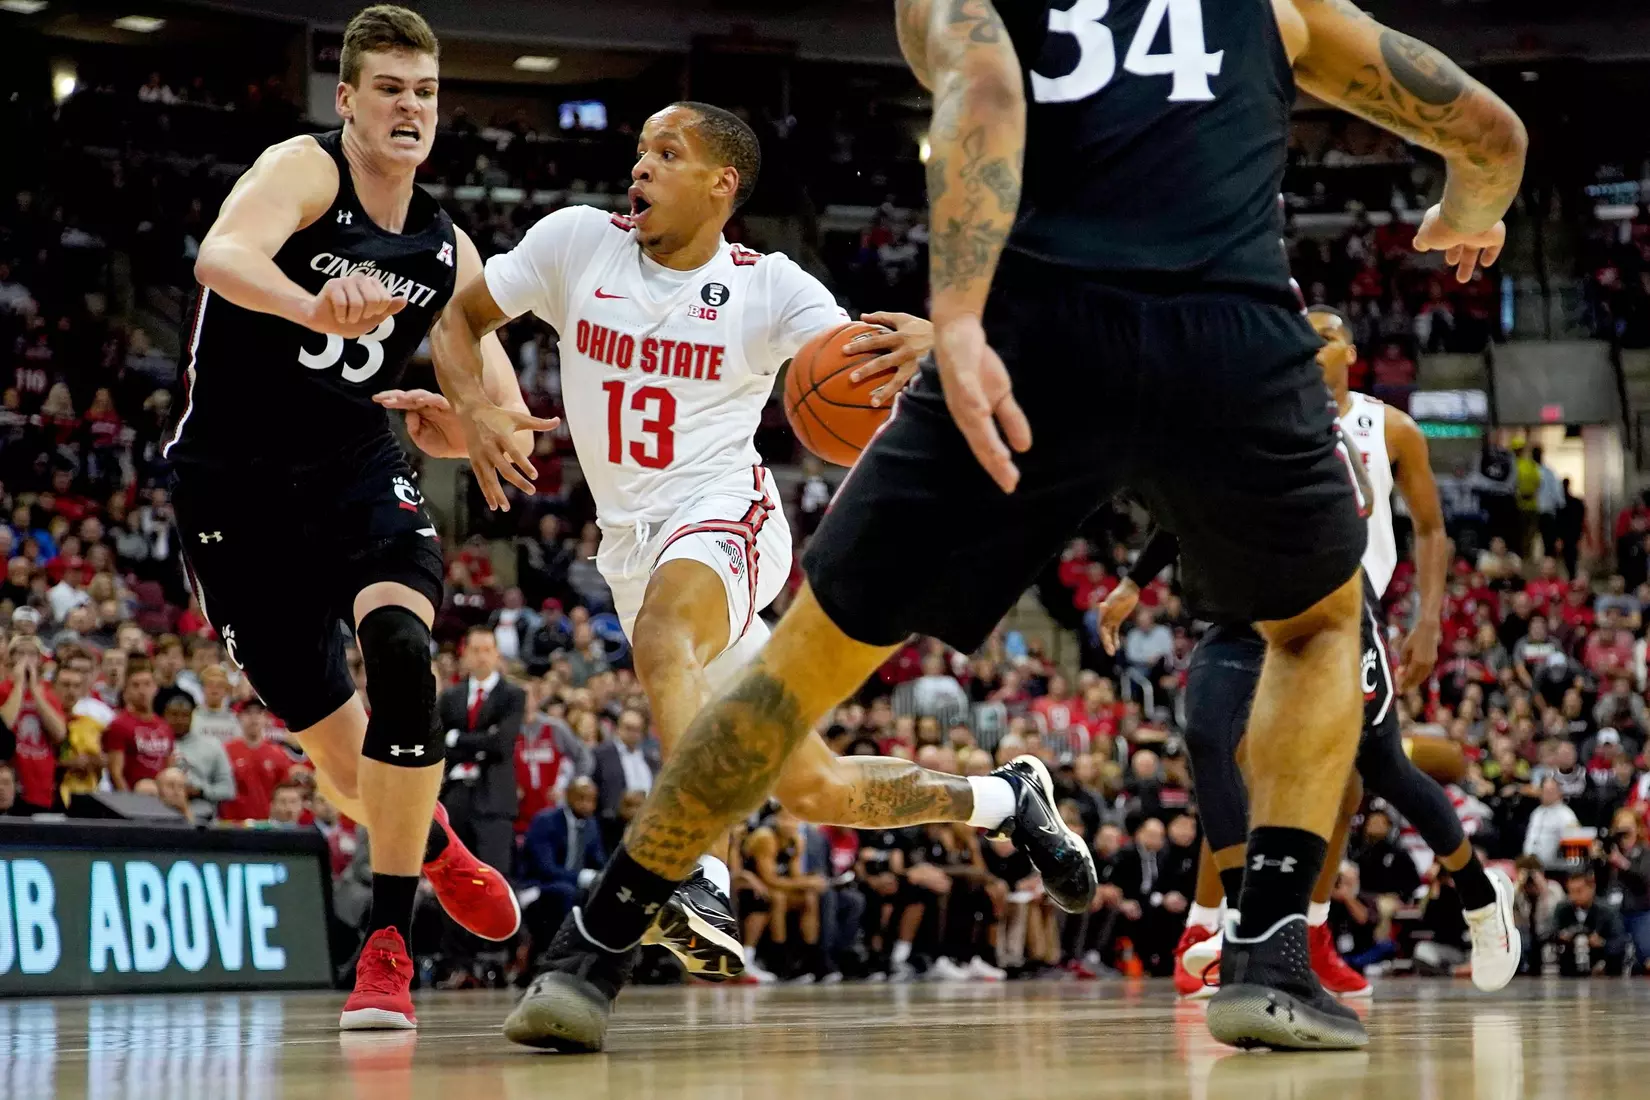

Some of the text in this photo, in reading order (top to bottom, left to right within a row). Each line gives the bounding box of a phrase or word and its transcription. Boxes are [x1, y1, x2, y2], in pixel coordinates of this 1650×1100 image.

[1029, 0, 1224, 103] 34
[576, 319, 725, 381] OHIO STATE
[602, 380, 677, 470] 13
[90, 860, 287, 973] ABOVE
